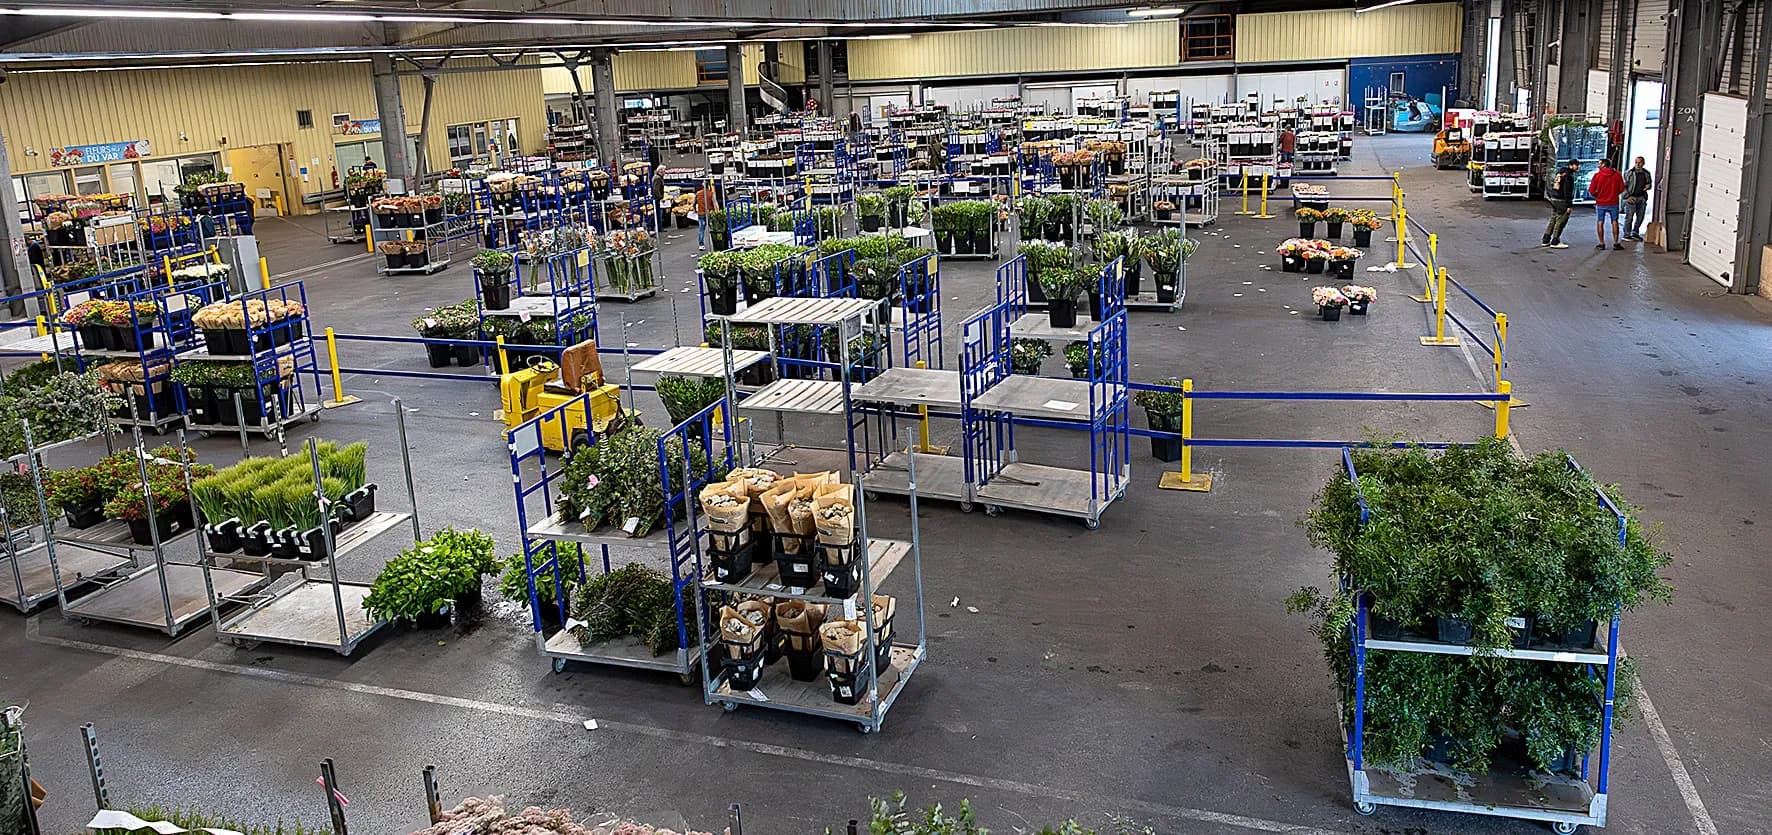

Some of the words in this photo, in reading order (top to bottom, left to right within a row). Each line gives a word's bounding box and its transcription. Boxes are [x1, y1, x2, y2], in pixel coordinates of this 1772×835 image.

[86, 146, 111, 155] FLEURS
[87, 154, 99, 162] DU
[101, 152, 119, 161] VAR
